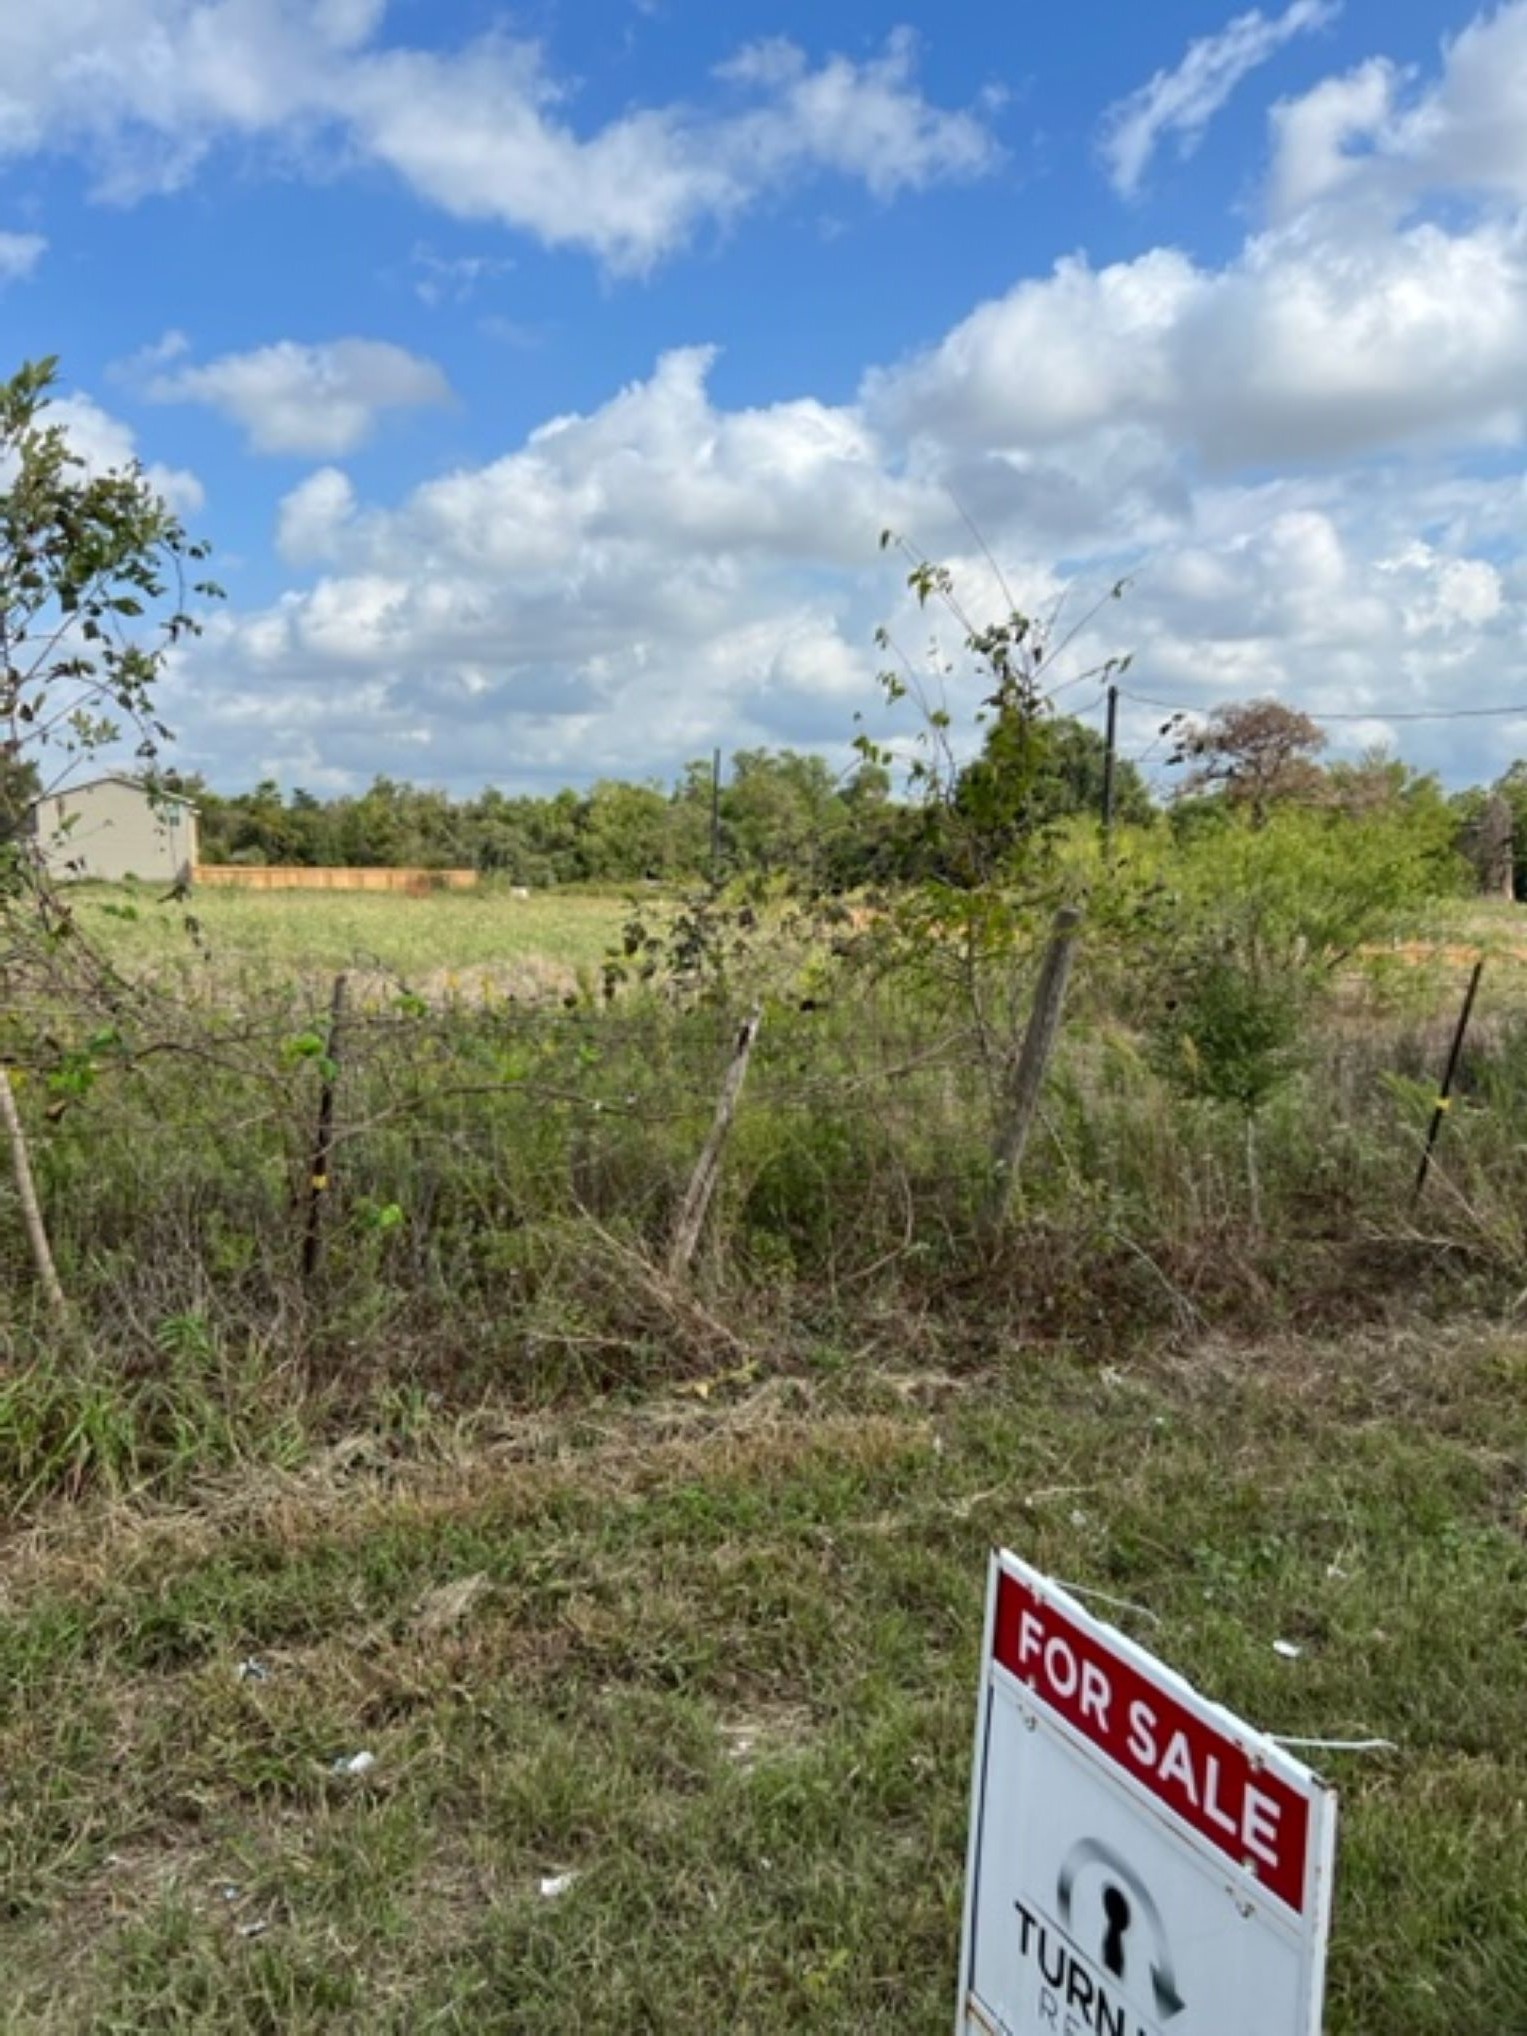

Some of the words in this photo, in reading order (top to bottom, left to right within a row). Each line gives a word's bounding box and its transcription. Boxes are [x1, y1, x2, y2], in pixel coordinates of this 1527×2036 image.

[1018, 1609, 1111, 1733] FOR
[1126, 1699, 1281, 1868] SALE
[1013, 1900, 1125, 2036] TURN
